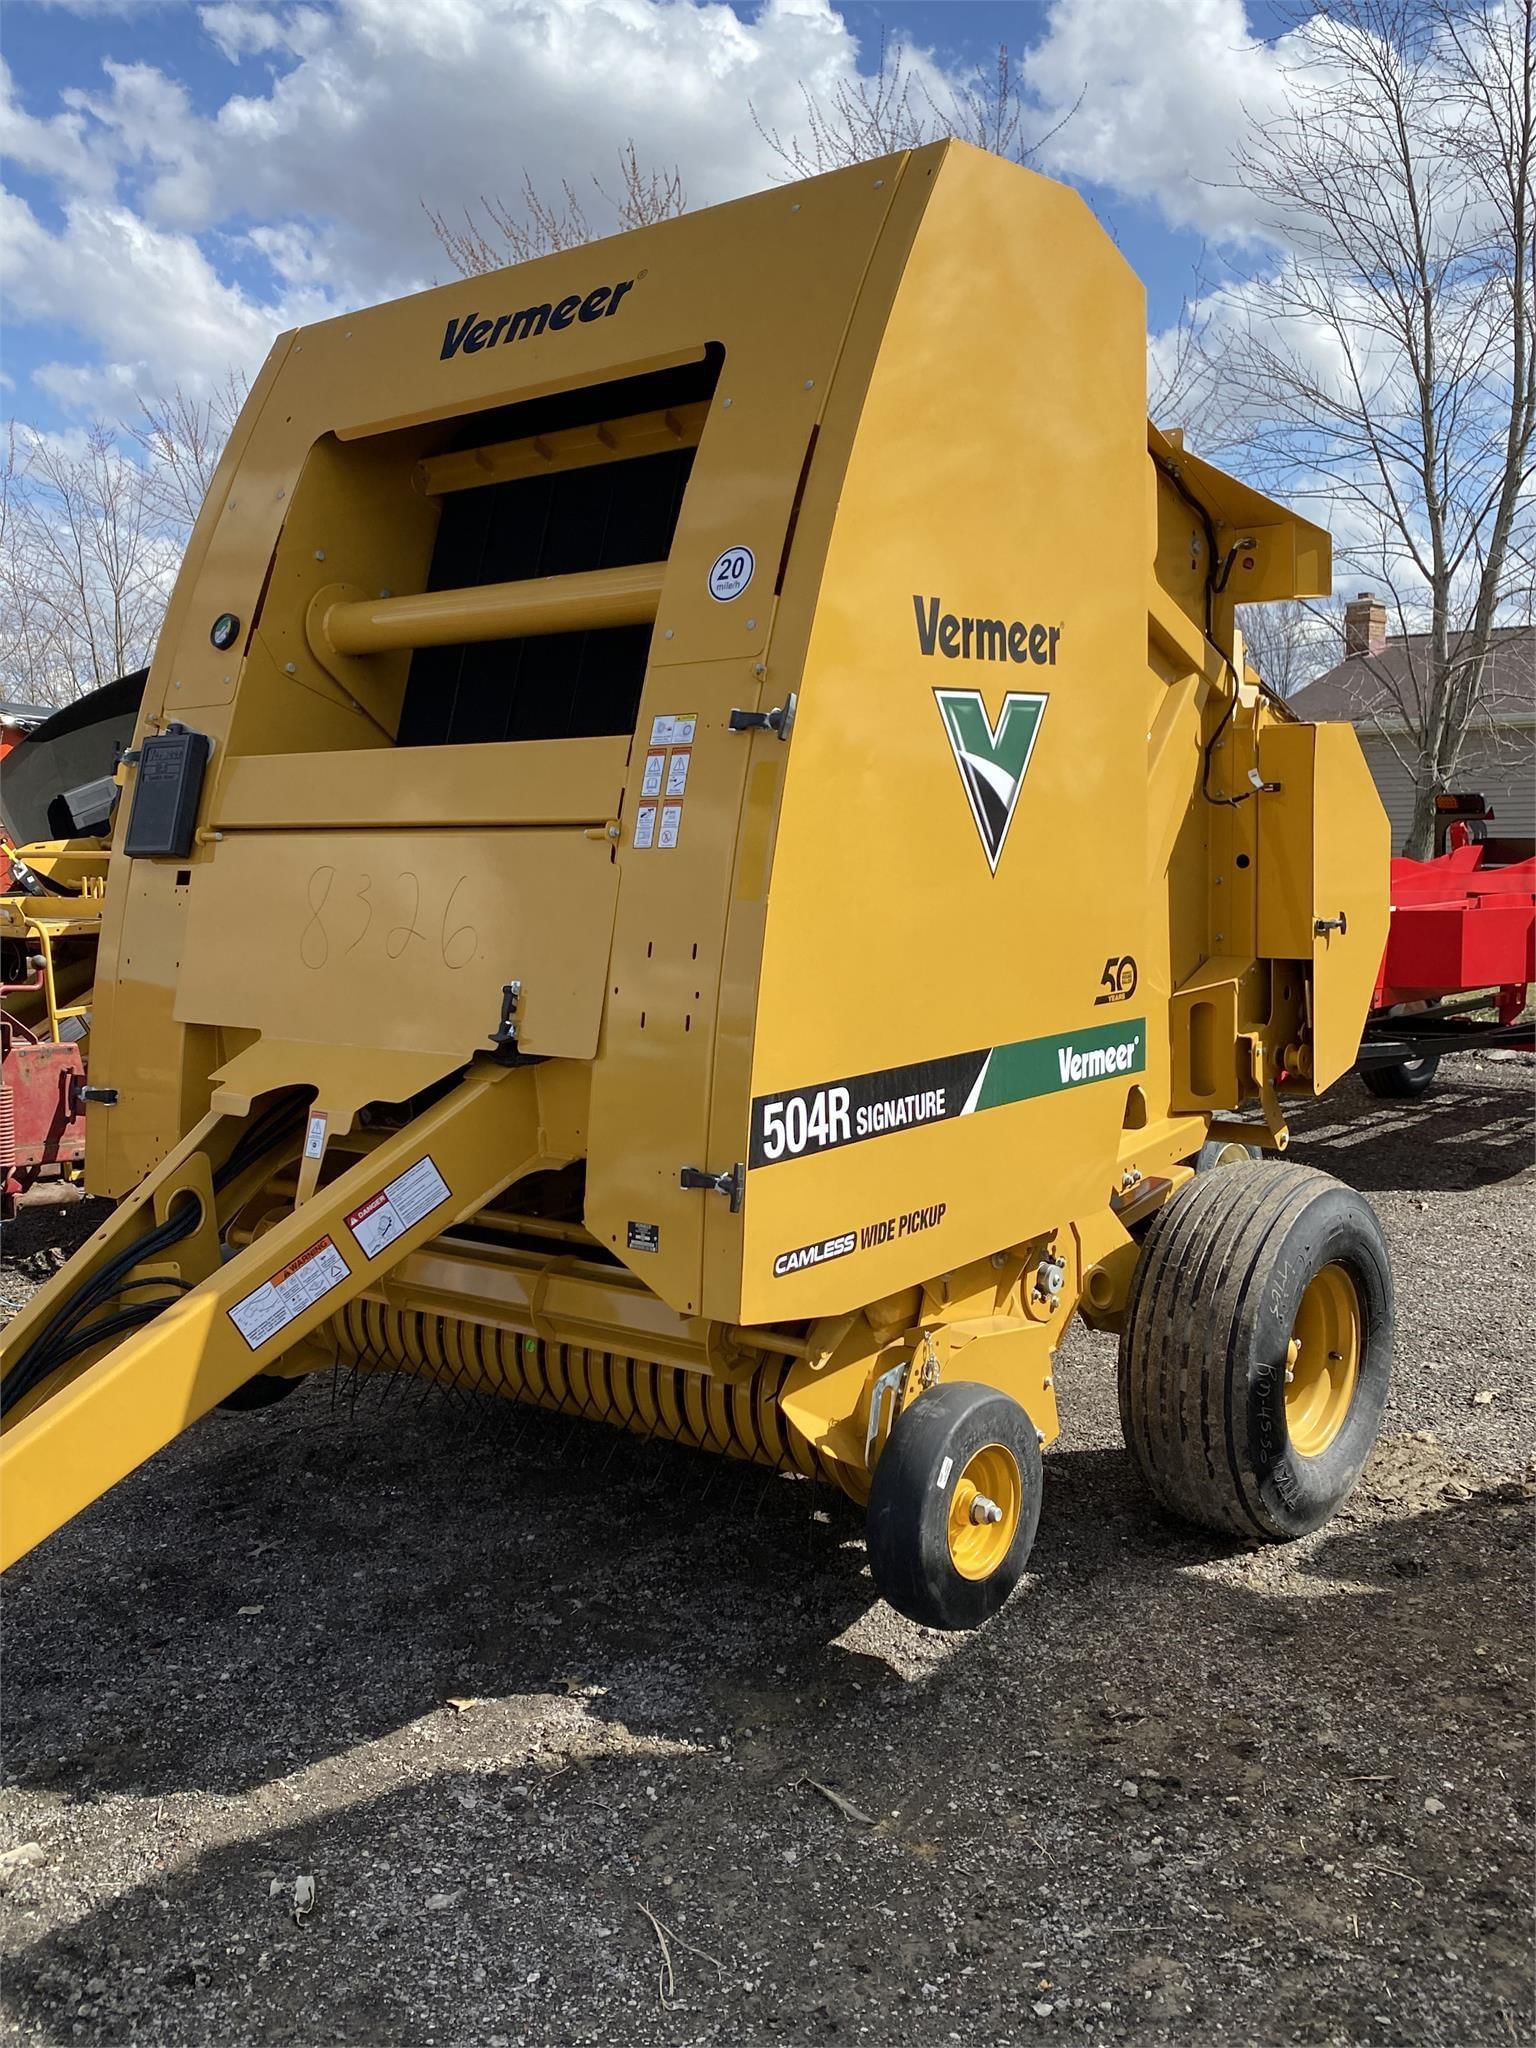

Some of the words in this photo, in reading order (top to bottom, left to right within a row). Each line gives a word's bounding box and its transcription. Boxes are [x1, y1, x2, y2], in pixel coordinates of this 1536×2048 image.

[439, 279, 634, 361] Vermeer
[717, 556, 745, 581] 20
[912, 594, 1061, 666] Vermeer
[1099, 954, 1138, 1002] 50
[1058, 1043, 1135, 1084] Vermeer
[762, 1086, 852, 1159] 504R
[855, 1088, 946, 1136] SIGNATURE
[357, 1195, 387, 1219] DANGER
[288, 1240, 328, 1272] WARNING
[775, 1233, 856, 1275] CAMLESS
[860, 1218, 896, 1251] WIDE
[898, 1202, 947, 1238] PICKUP
